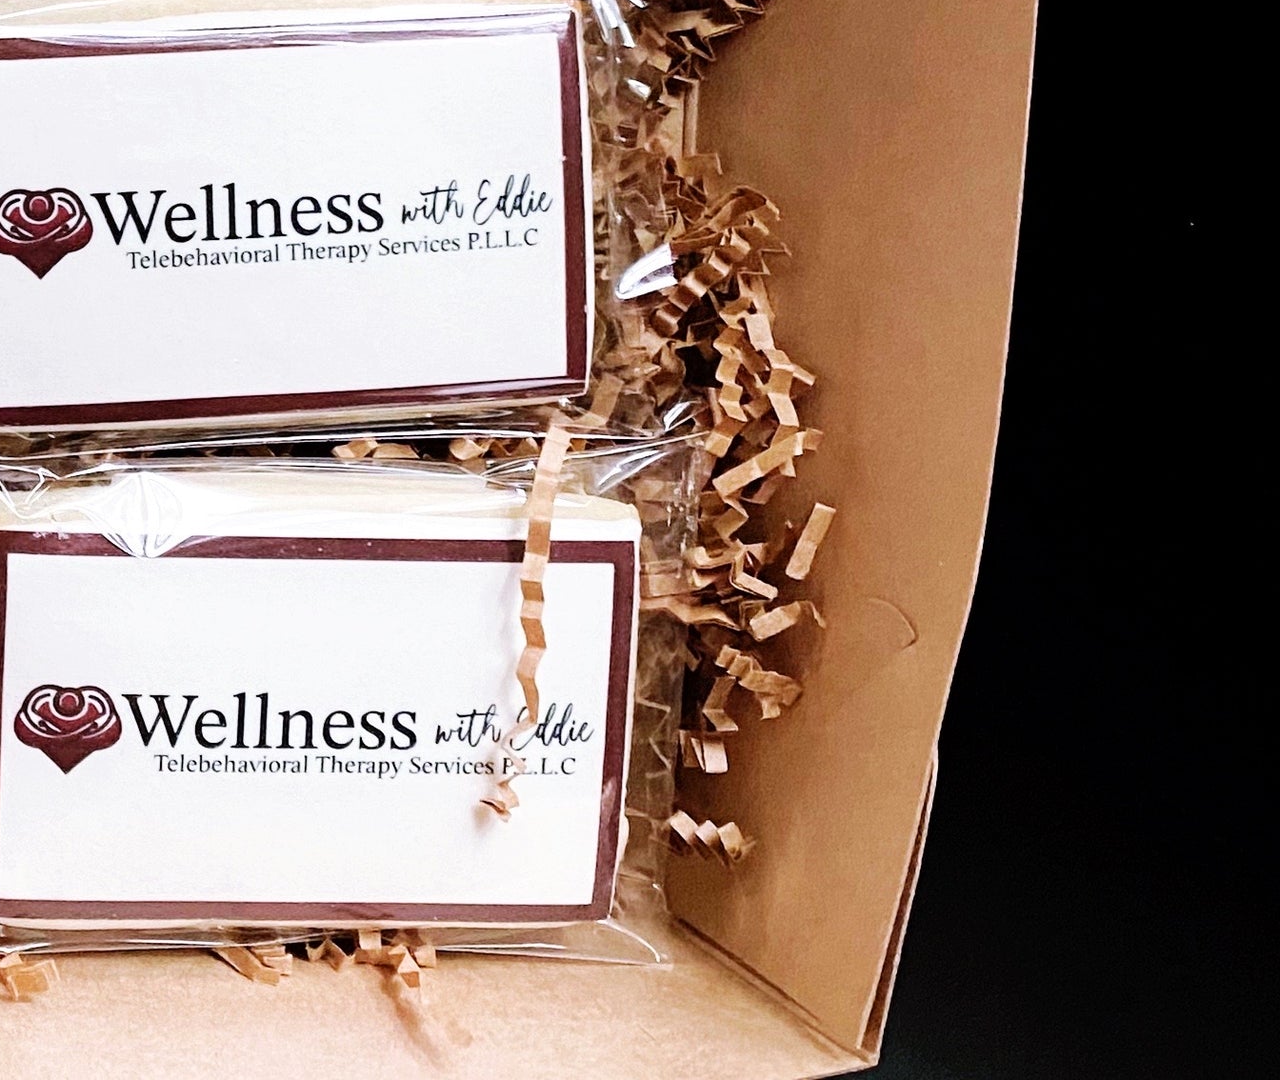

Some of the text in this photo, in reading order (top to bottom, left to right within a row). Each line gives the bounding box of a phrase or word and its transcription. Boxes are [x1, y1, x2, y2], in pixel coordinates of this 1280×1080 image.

[90, 174, 552, 245] Wellness with Eddie
[126, 228, 538, 269] Telebehavioral Therapy Services P.L.L.C
[121, 692, 417, 750] Wellness
[435, 704, 501, 747] with
[154, 754, 307, 773] Telebehavioral
[316, 755, 402, 779] Therapy
[409, 757, 494, 775] Services
